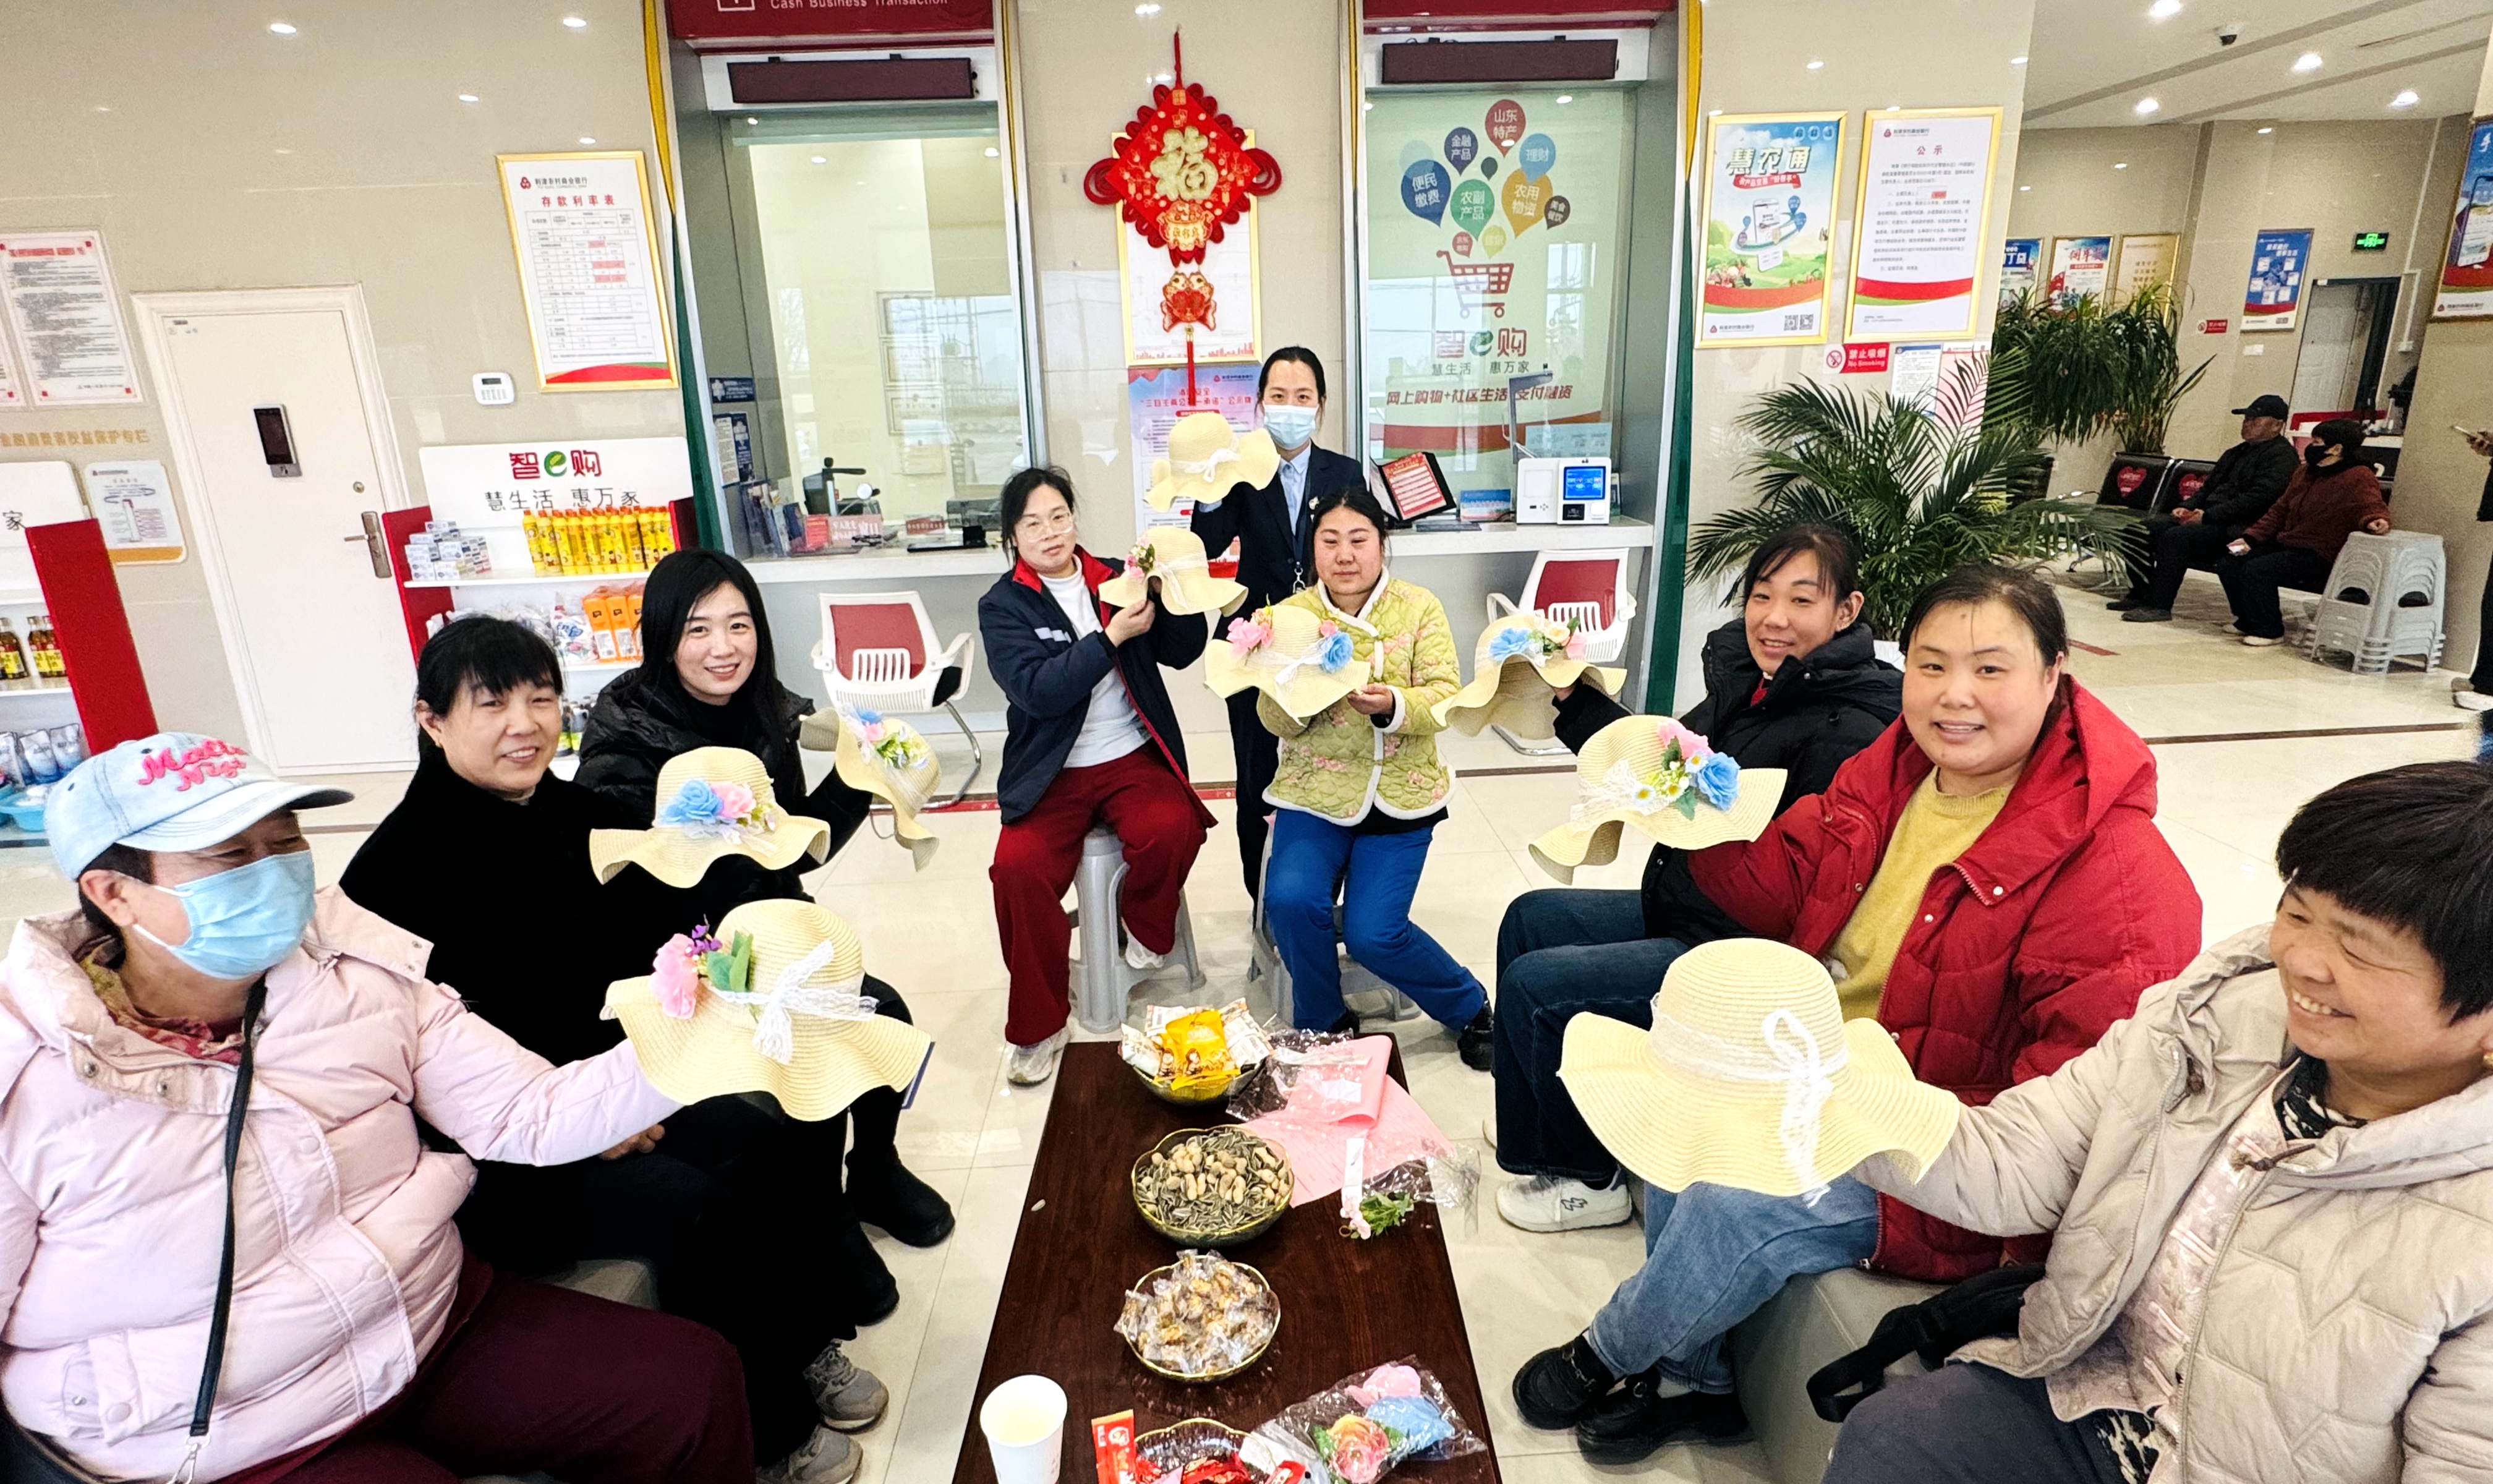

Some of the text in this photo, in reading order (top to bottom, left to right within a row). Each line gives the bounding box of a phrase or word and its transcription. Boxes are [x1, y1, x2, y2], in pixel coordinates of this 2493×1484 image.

[771, 0, 803, 9] Cash
[810, 0, 866, 8] Business
[1494, 108, 1518, 123] 山东
[1493, 125, 1517, 139] 特产
[1451, 134, 1472, 147] 金融
[1451, 148, 1472, 161] 产品
[1525, 147, 1550, 162] 理财
[1917, 145, 1943, 155] 公示
[1150, 125, 1219, 201] 福
[1726, 146, 1812, 176] 慧农通
[1412, 173, 1438, 191] 便民
[1415, 190, 1441, 208] 缴费
[1460, 190, 1485, 205] 农副
[1515, 184, 1540, 200] 农用
[542, 194, 615, 207] 存款利率表
[1512, 199, 1536, 216] 物资
[1460, 206, 1485, 220] 产品
[1432, 360, 1529, 376] 慧生活 惠万家
[1386, 385, 1574, 405] 网上购物+社区生活支付融资
[509, 450, 602, 480] 智e购
[485, 487, 640, 512] 慧生活 惠万家
[2, 510, 26, 531] 家
